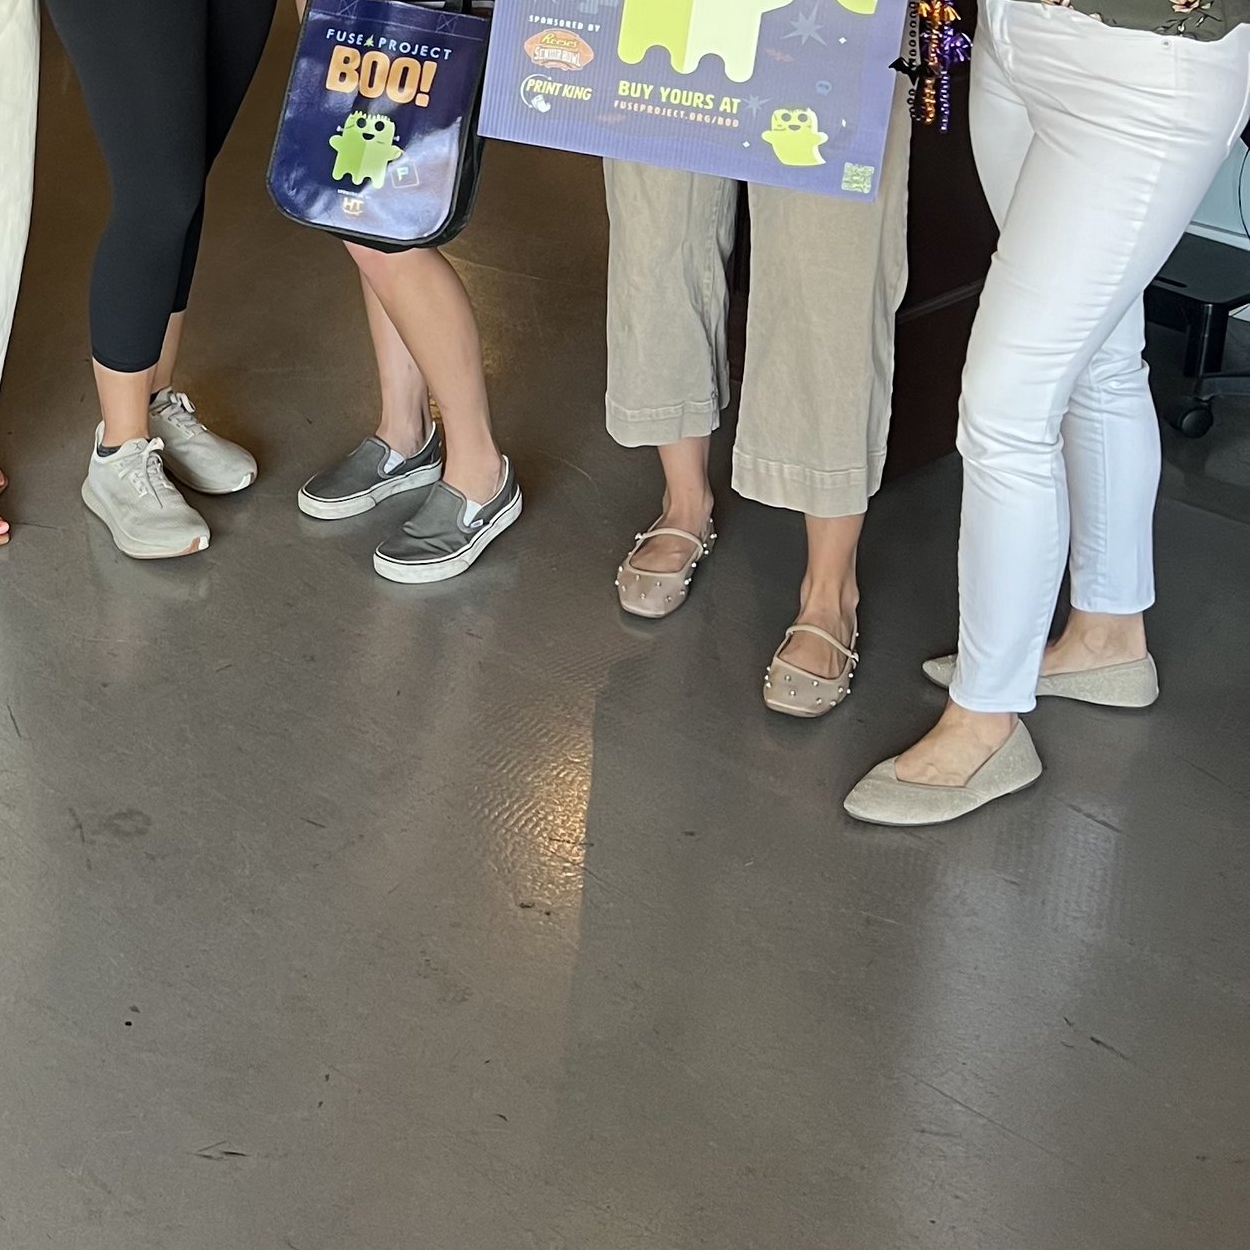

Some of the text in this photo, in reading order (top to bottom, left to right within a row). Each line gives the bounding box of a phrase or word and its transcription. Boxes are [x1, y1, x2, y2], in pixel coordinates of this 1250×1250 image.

[528, 15, 601, 33] SPONSORED BY
[326, 28, 452, 61] FUSE PROJECT
[325, 44, 438, 108] BOO!
[526, 78, 593, 101] PRINT KING
[617, 80, 741, 114] BUY YOURS AT
